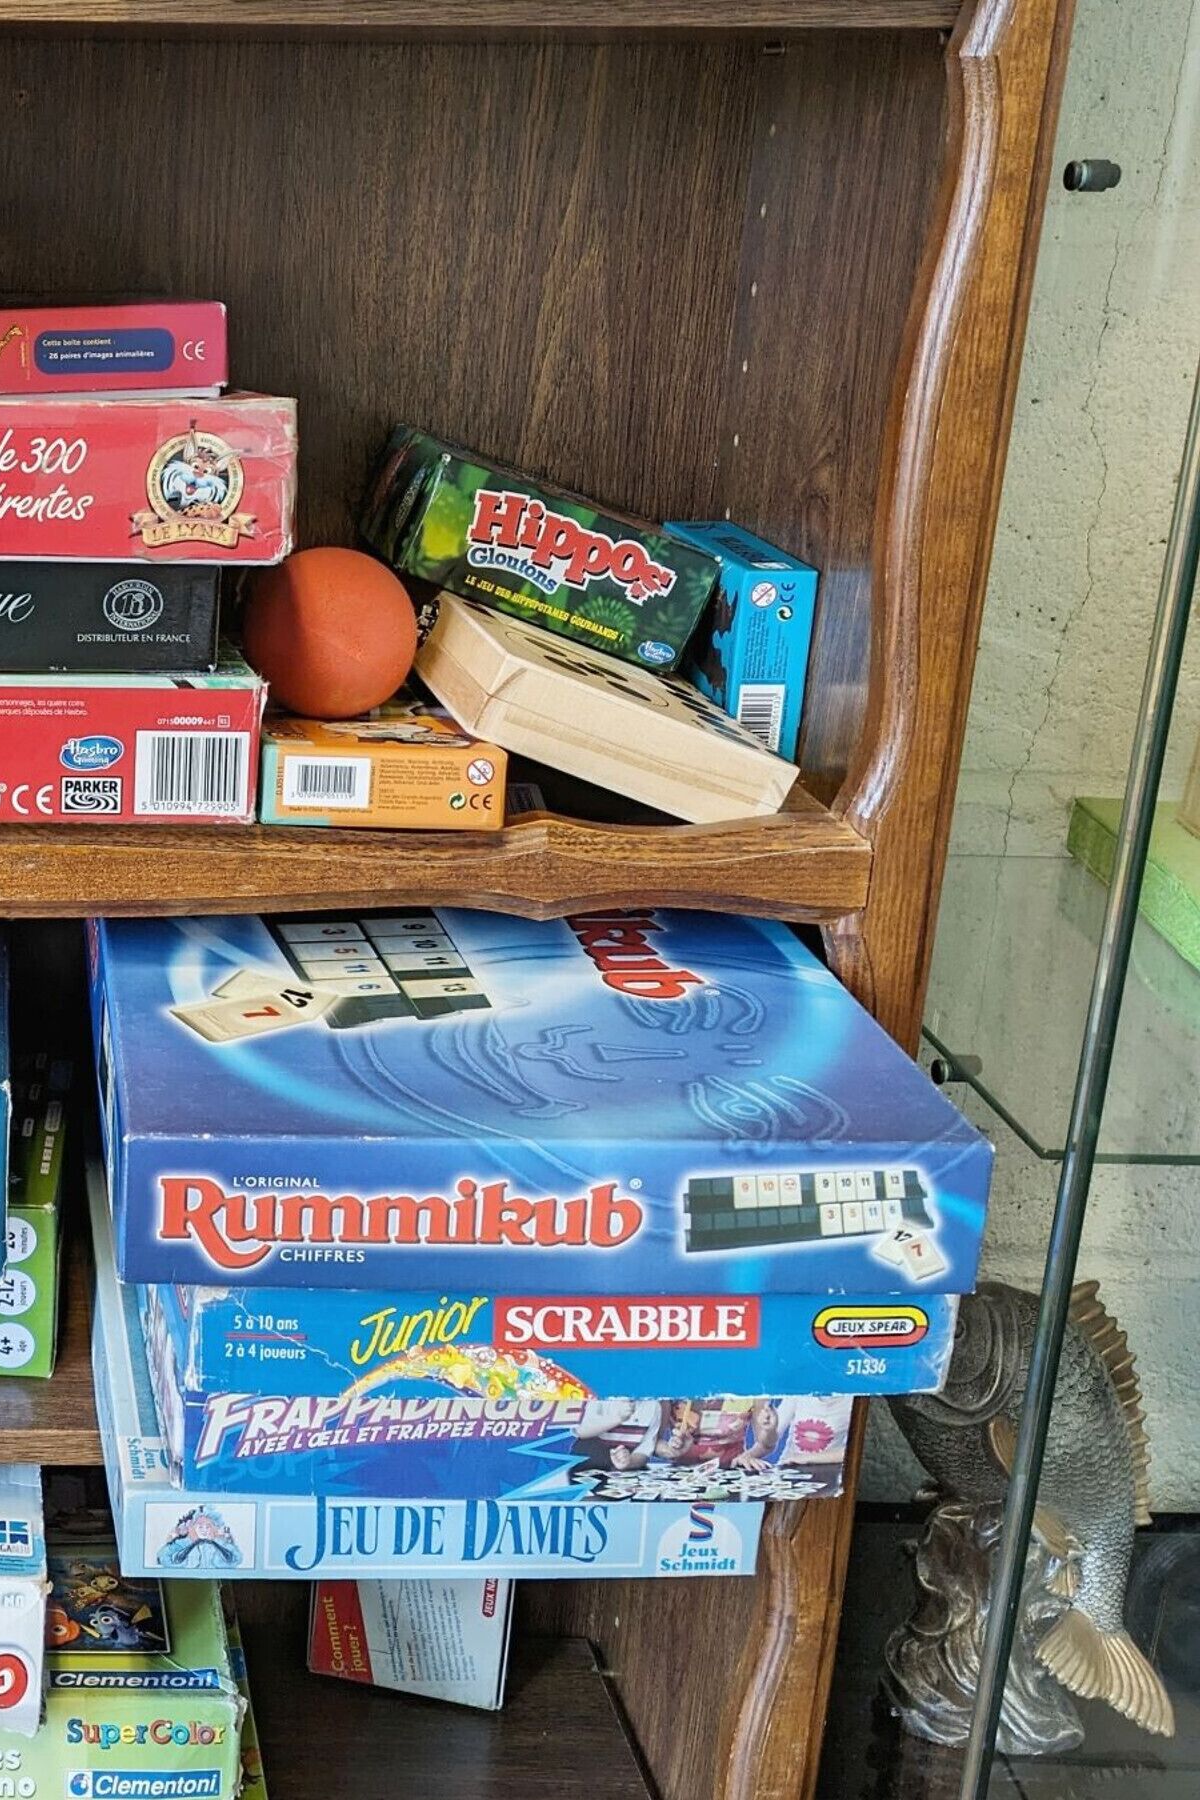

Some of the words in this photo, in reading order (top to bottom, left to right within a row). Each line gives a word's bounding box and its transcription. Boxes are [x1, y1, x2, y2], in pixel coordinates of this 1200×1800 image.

[43, 338, 62, 346] Cette
[62, 337, 81, 346] boîte
[83, 337, 112, 345] contient
[60, 351, 82, 360] paires
[83, 350, 113, 359] d'images
[115, 350, 154, 358] animalières
[22, 436, 88, 474] 300
[468, 491, 676, 600] Hippos
[468, 547, 558, 594] Gloutons
[464, 574, 477, 586] LE
[478, 579, 495, 592] JEU
[495, 586, 513, 600] DES
[511, 591, 571, 622] HIPPOPOTAMES
[77, 632, 140, 643] DISTRIBUTEUR
[141, 633, 154, 643] EN
[155, 633, 191, 643] FRANCE
[66, 739, 118, 757] Hasbro
[64, 779, 119, 793] PARKER
[233, 1175, 320, 1188] L'ORIGINAL
[159, 1177, 643, 1269] Rummikub
[280, 1248, 365, 1264] CHIFFRES
[233, 1315, 243, 1329] 5
[246, 1314, 255, 1330] à
[258, 1315, 273, 1331] 10
[276, 1317, 299, 1331] ans
[350, 1293, 489, 1365] Junior
[505, 1303, 746, 1347] SCRABBLE
[833, 1321, 865, 1333] JEUX
[868, 1320, 908, 1332] SPEAR
[224, 1343, 233, 1358] 2
[236, 1343, 245, 1358] à
[247, 1344, 256, 1358] 4
[260, 1345, 307, 1361] joueurs
[845, 1358, 887, 1376] 51336
[197, 1396, 584, 1461] FRAPPADINGUE
[238, 1436, 287, 1458] AYEZ
[293, 1429, 351, 1450] L'ŒIL
[356, 1426, 378, 1443] ET
[385, 1420, 476, 1441] FRAPPEZ
[481, 1419, 532, 1438] FORT
[127, 1436, 145, 1481] Schmidt
[285, 1496, 383, 1571] JEU
[394, 1505, 445, 1556] DE
[460, 1500, 609, 1562] DAMES
[678, 1542, 719, 1558] Jeux
[660, 1556, 737, 1572] Schmidt
[3, 1593, 25, 1607] UN
[324, 1597, 344, 1671] Comment
[351, 1634, 368, 1673] jouer
[54, 1671, 214, 1688] Clementoni
[66, 1718, 226, 1749] SuperColor
[95, 1771, 217, 1796] Clementoni
